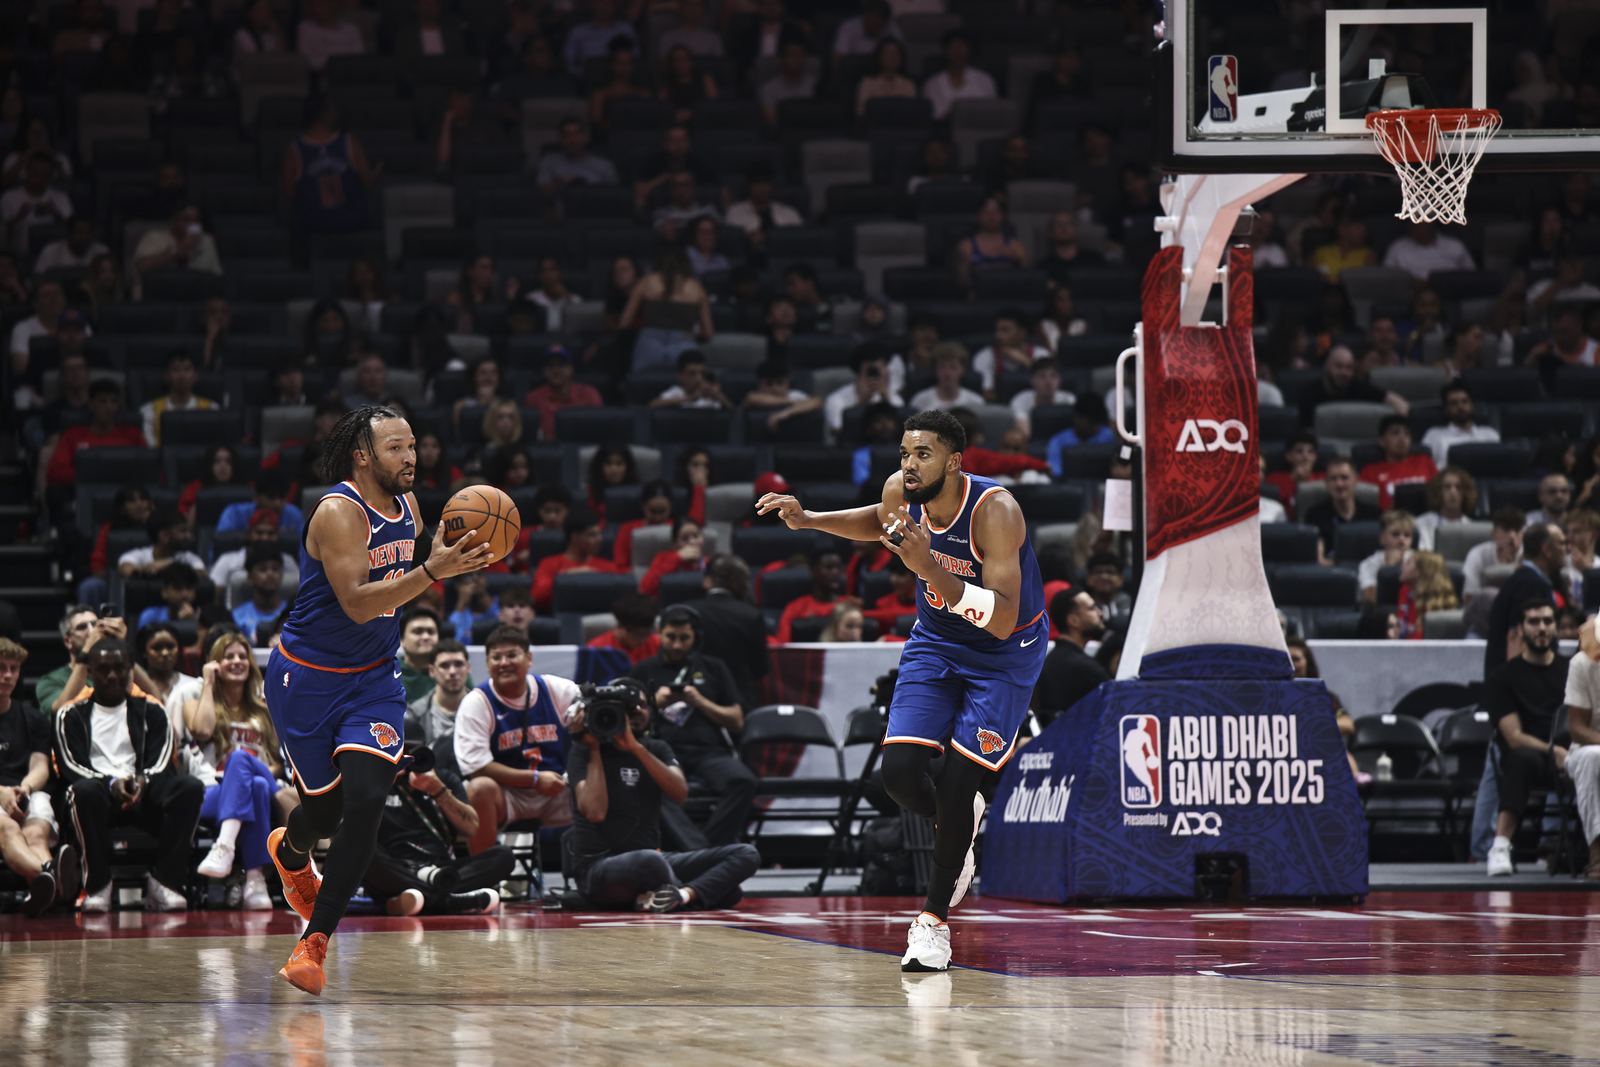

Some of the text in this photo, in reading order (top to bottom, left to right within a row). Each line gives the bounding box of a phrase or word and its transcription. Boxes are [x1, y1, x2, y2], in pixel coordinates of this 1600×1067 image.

[1213, 107, 1228, 118] NBA
[1176, 419, 1249, 454] ADQ
[367, 539, 416, 570] NEW YOR
[1167, 714, 1298, 760] ABU DHABI
[1127, 787, 1147, 802] NBA
[1168, 759, 1325, 806] GAMES 2025
[1123, 812, 1168, 827] Presented by
[1171, 811, 1222, 836] ADQ
